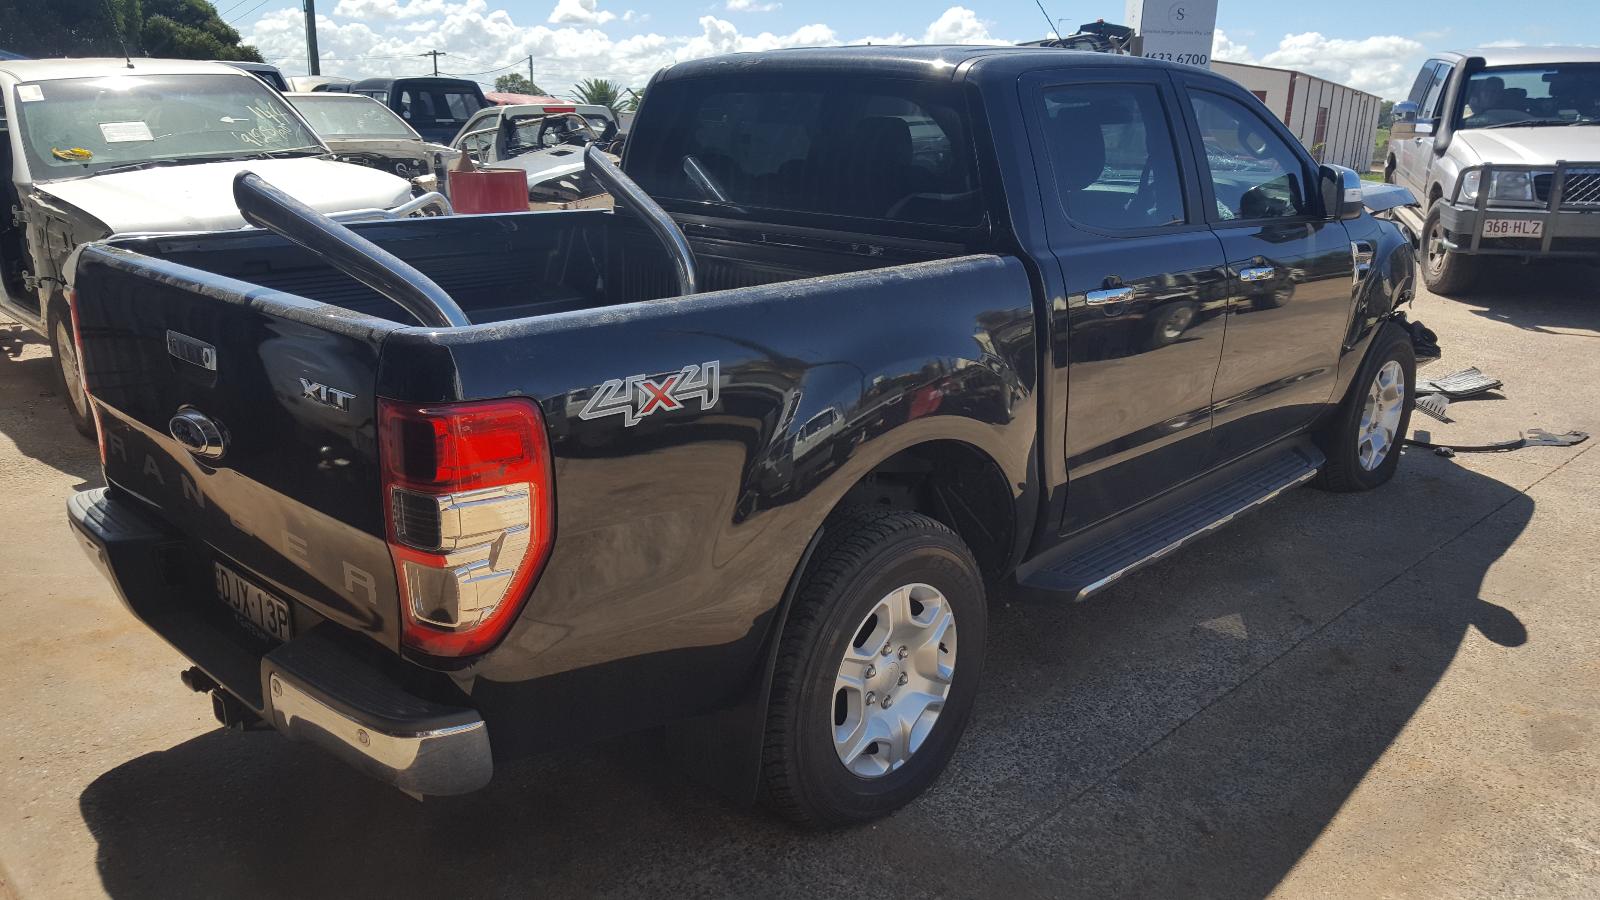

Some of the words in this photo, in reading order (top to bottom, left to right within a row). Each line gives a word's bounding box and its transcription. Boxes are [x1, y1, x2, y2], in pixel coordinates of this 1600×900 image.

[1176, 7, 1185, 21] S
[1176, 53, 1207, 65] 6700
[300, 377, 357, 413] XLT
[106, 431, 377, 605] RANER
